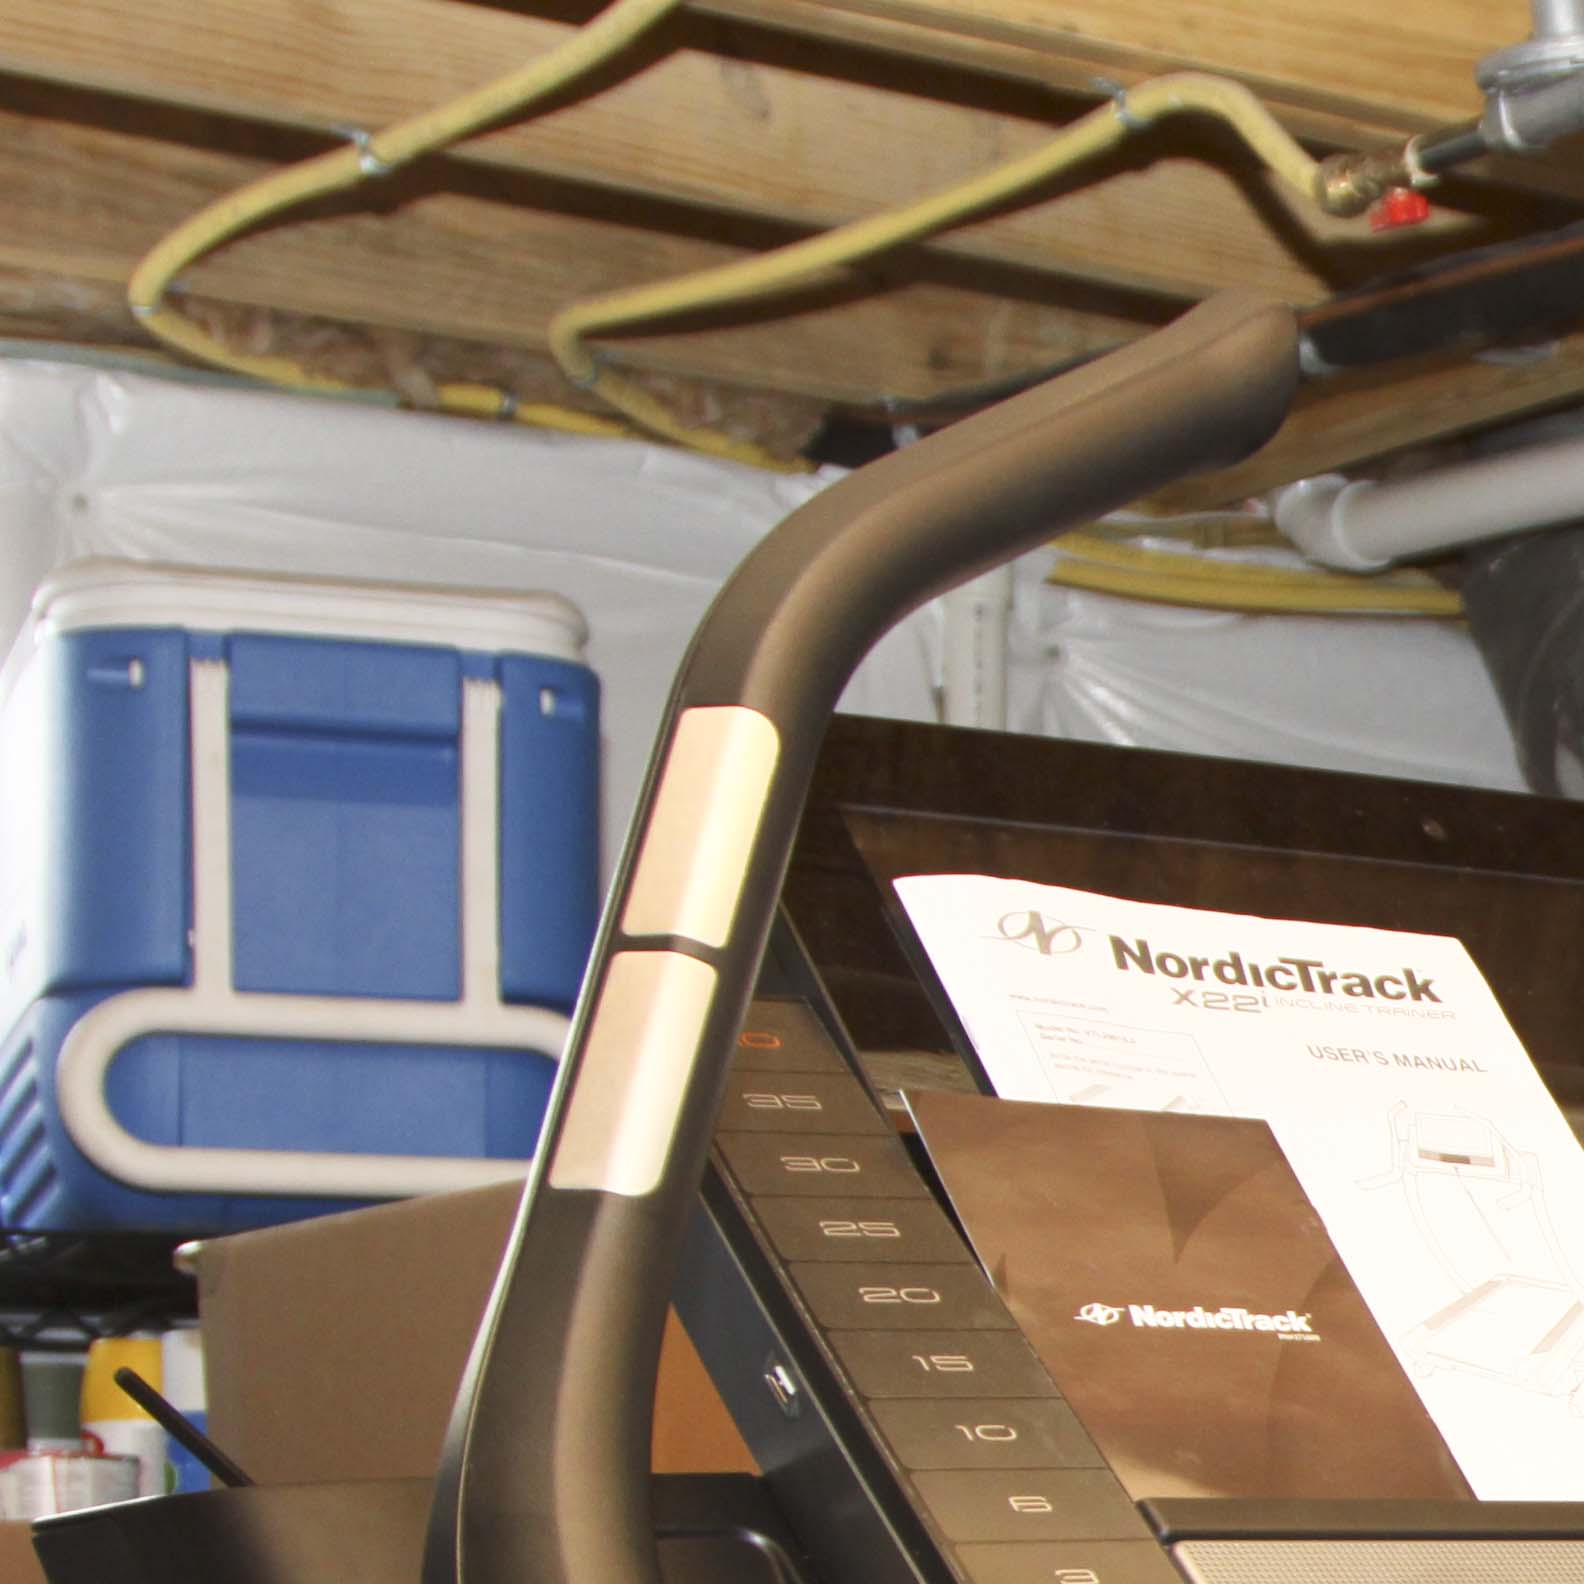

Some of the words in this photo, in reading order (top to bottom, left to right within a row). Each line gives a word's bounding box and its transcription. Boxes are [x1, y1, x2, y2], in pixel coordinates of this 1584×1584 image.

[1109, 934, 1443, 1004] NordicTrack
[1366, 1004, 1456, 1021] TRAINER
[738, 1031, 784, 1049] 0
[1306, 1045, 1389, 1066] USER'S
[1394, 1053, 1488, 1073] MANUAL
[742, 1093, 822, 1110] 35
[780, 1156, 860, 1173] 30
[819, 1220, 901, 1237] 25
[858, 1287, 941, 1303] 20
[1128, 1304, 1313, 1332] NordicTrack
[912, 1355, 974, 1372] 15
[955, 1424, 1018, 1441] 10
[1007, 1495, 1054, 1513] 6
